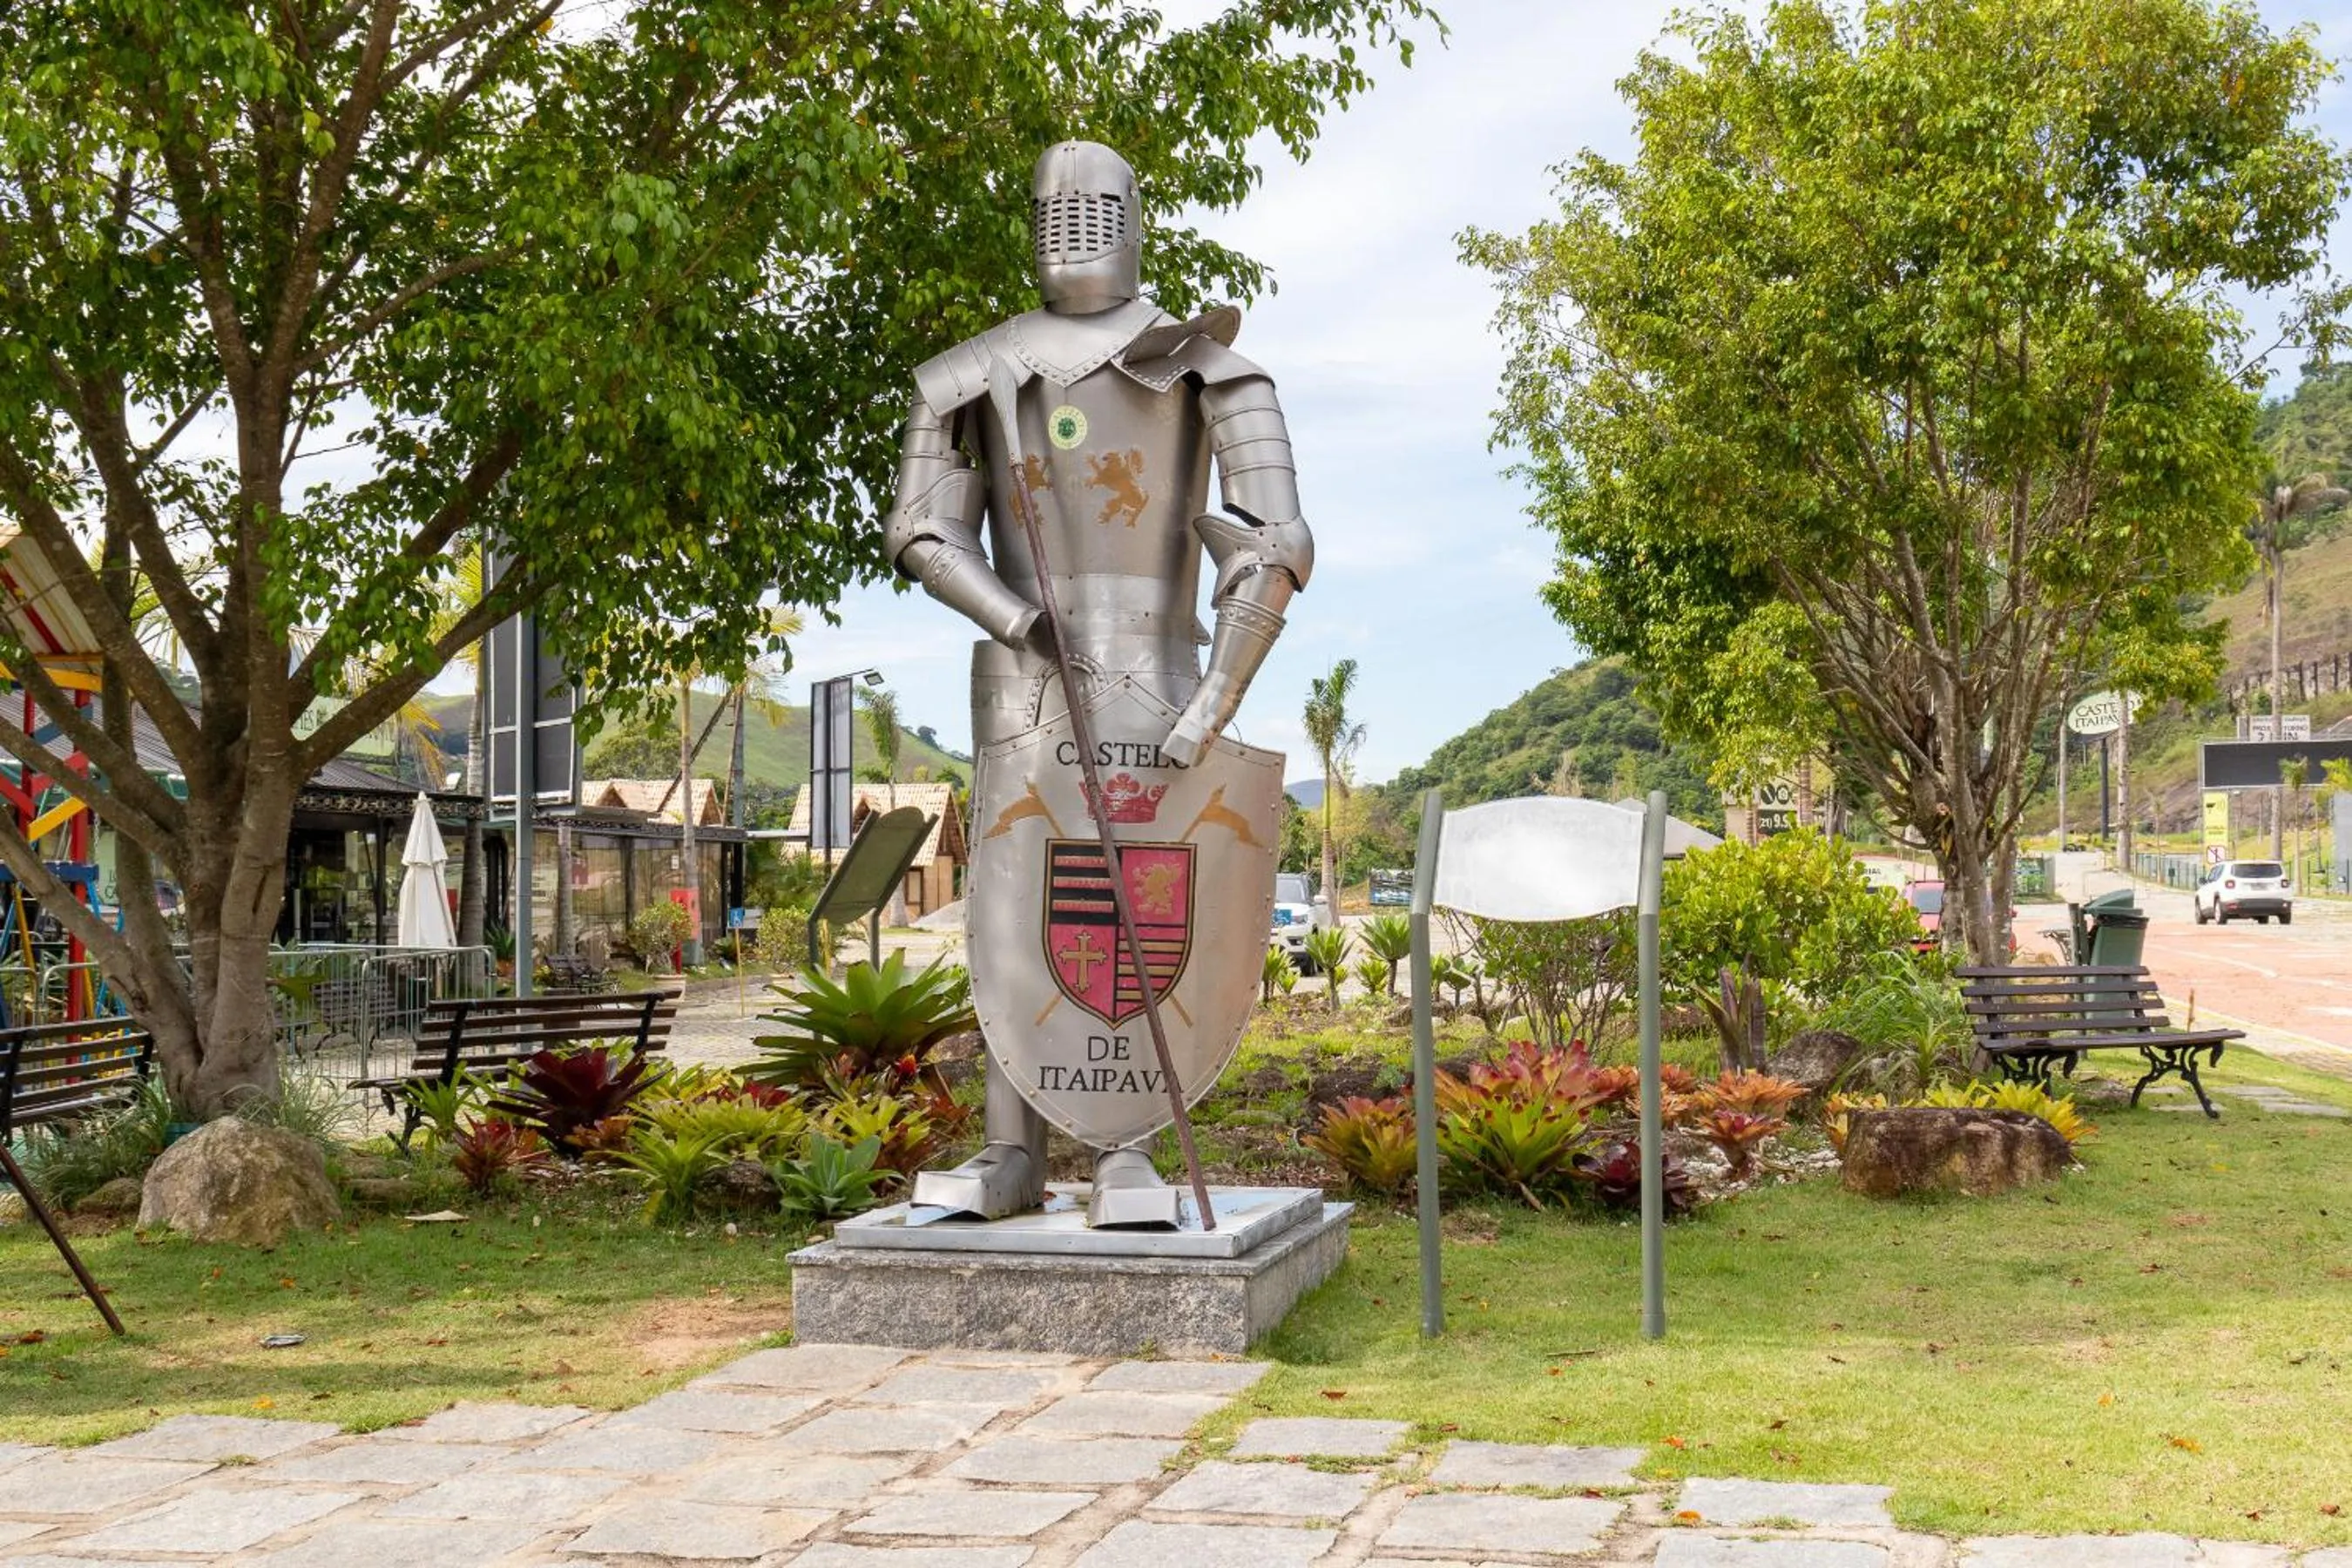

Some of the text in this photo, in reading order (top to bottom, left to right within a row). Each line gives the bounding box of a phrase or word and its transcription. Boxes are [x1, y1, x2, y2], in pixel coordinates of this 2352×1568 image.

[1056, 740, 1190, 770] CSTEL
[1087, 1035, 1131, 1061] DE
[1037, 1065, 1185, 1094] ITAIPAV
